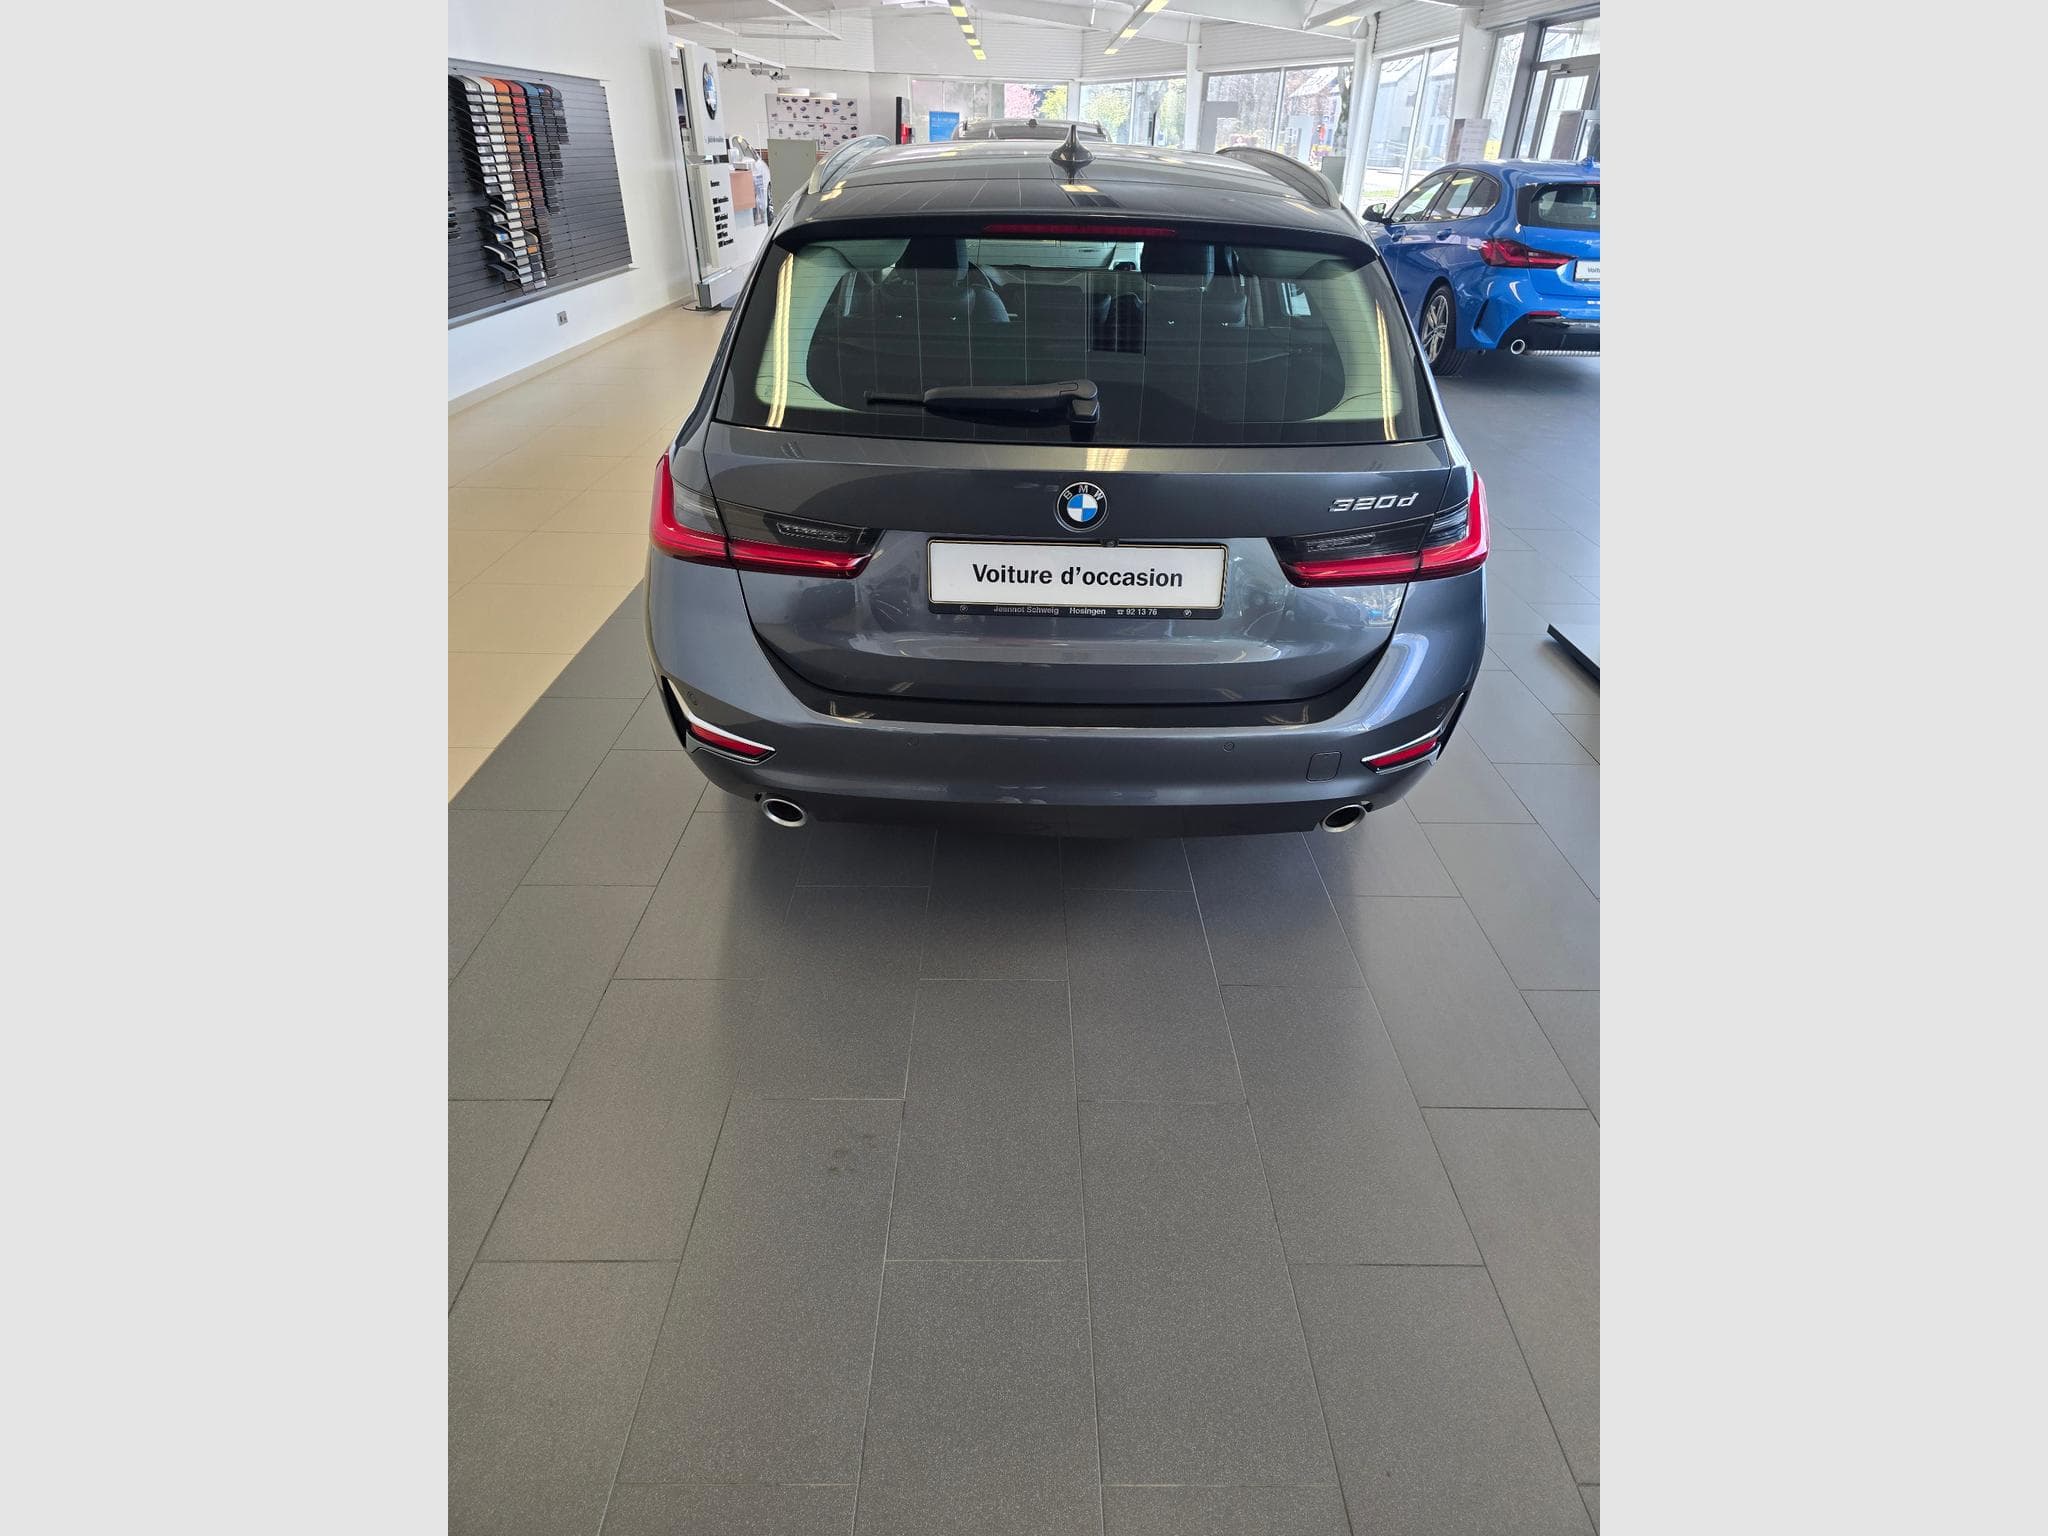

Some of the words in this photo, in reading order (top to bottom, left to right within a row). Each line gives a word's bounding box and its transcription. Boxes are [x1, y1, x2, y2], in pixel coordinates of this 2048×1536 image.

[1063, 484, 1104, 500] BMW
[1328, 492, 1419, 512] 320d
[972, 563, 1053, 585] Voiture
[1061, 566, 1183, 587] d’occasion
[1069, 607, 1106, 616] Hosingen
